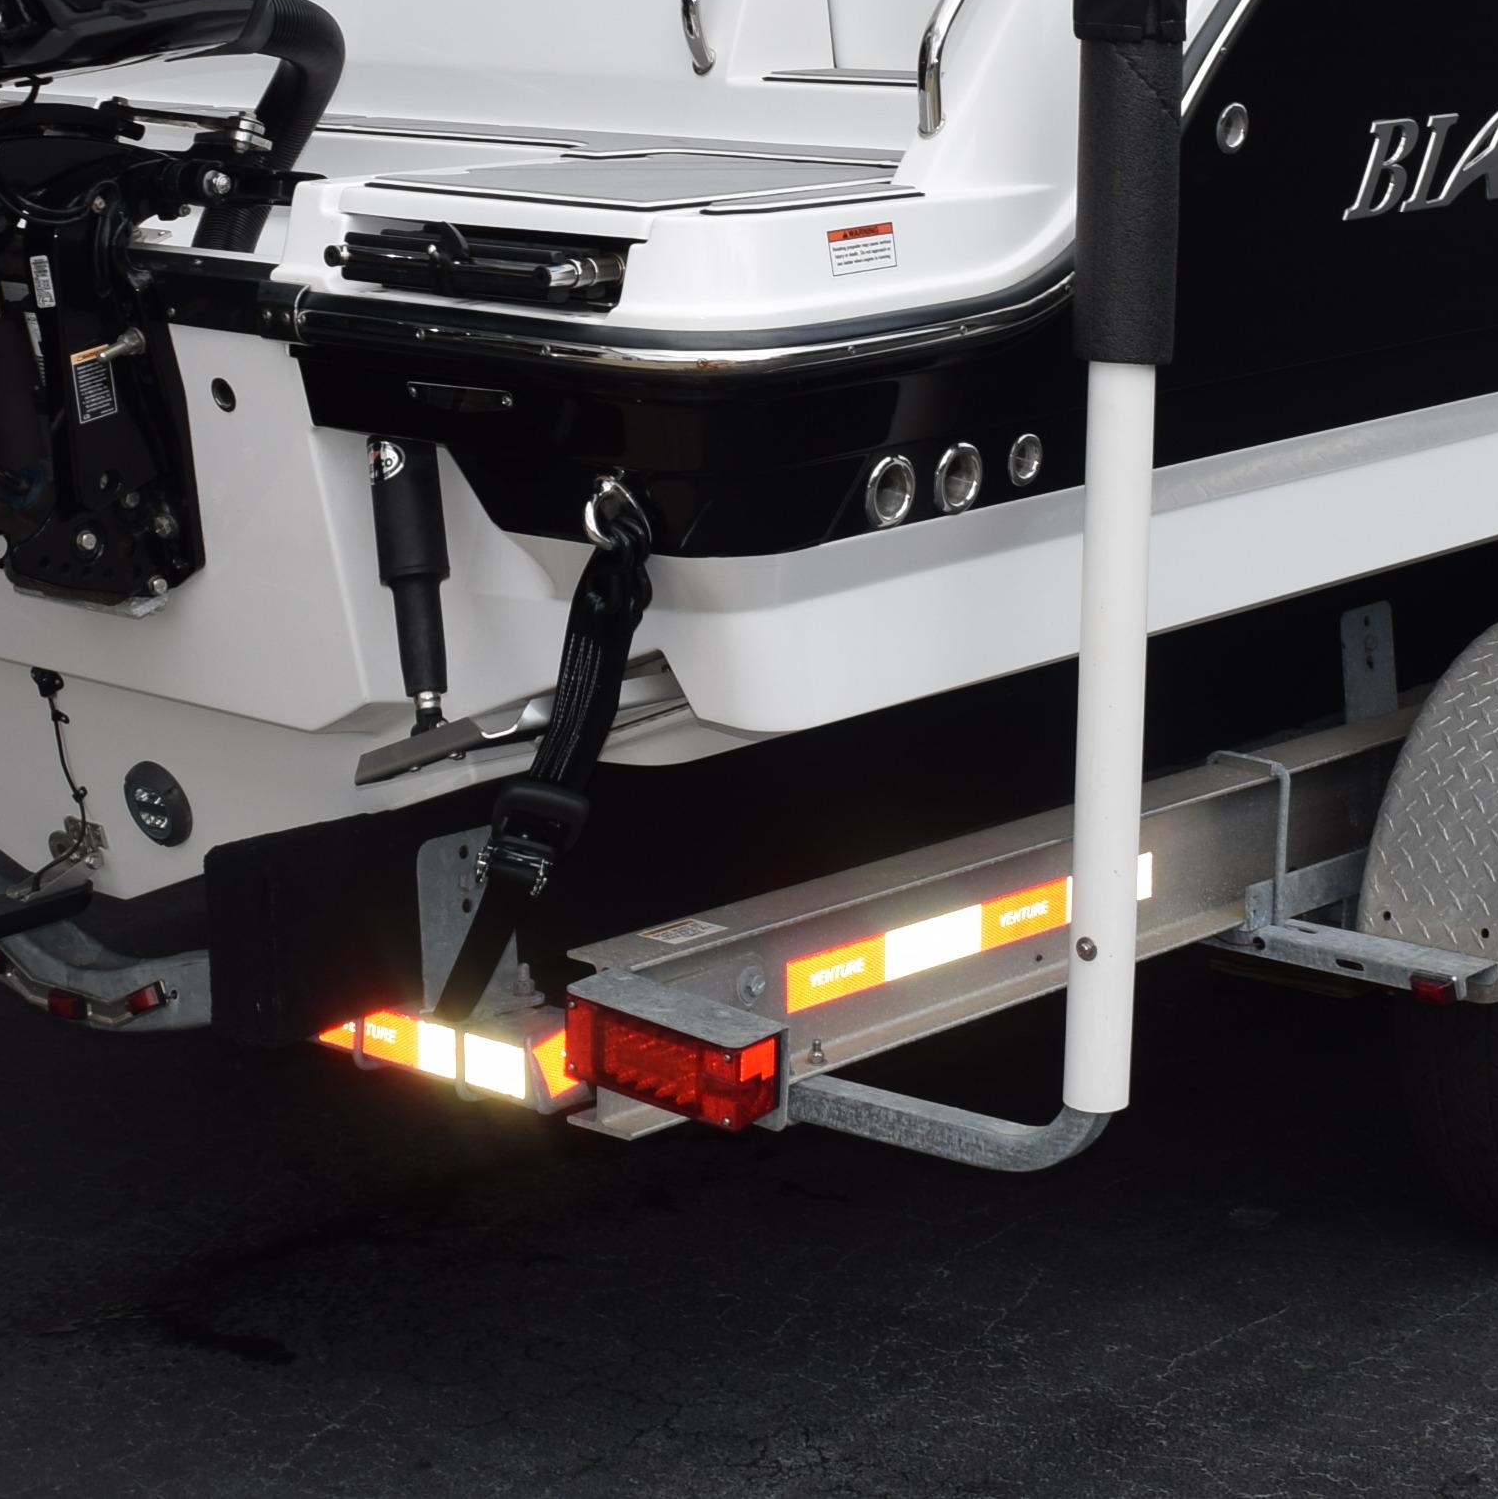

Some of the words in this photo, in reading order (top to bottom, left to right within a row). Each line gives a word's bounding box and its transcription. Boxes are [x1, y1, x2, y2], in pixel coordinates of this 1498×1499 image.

[849, 226, 879, 237] WARNING
[999, 899, 1049, 928] VENTURE
[809, 957, 866, 988] VENTURE
